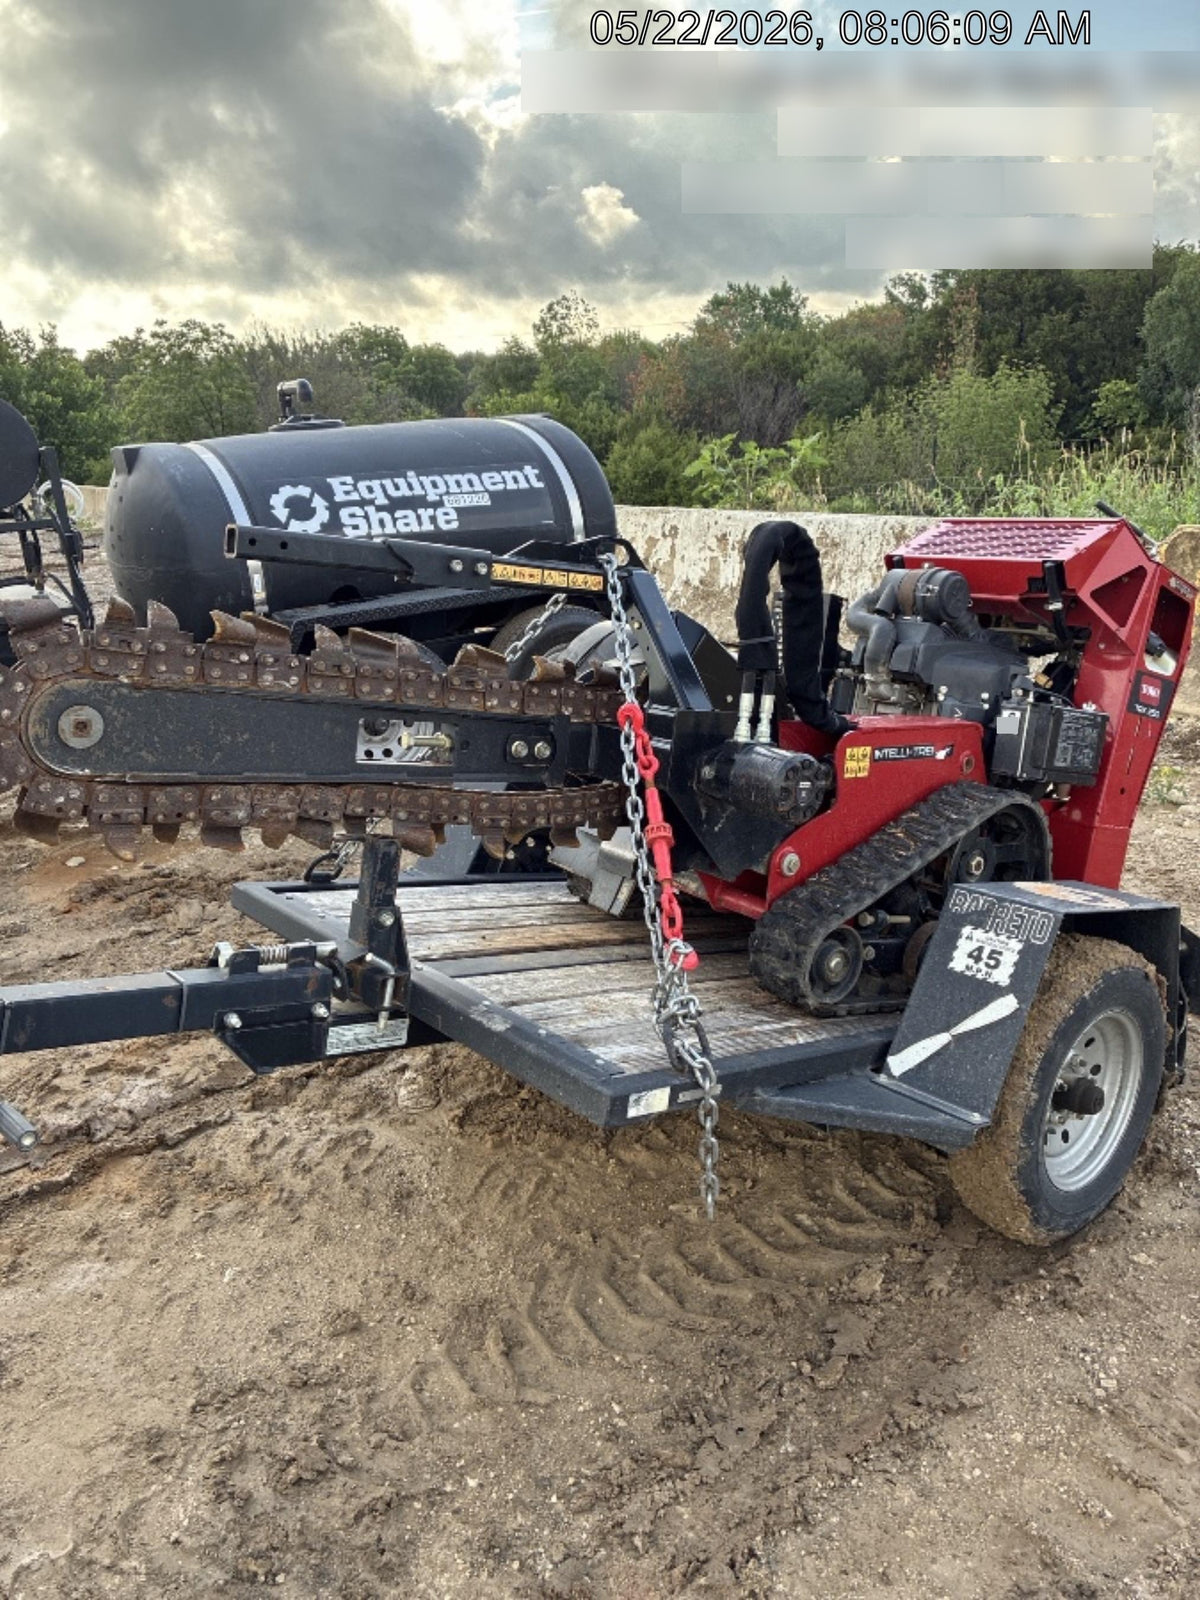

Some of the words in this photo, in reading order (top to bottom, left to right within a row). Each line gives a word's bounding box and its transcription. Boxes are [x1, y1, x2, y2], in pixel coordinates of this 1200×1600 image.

[326, 465, 545, 505] Equipment
[339, 506, 459, 538] Share
[967, 945, 1004, 971] 45
